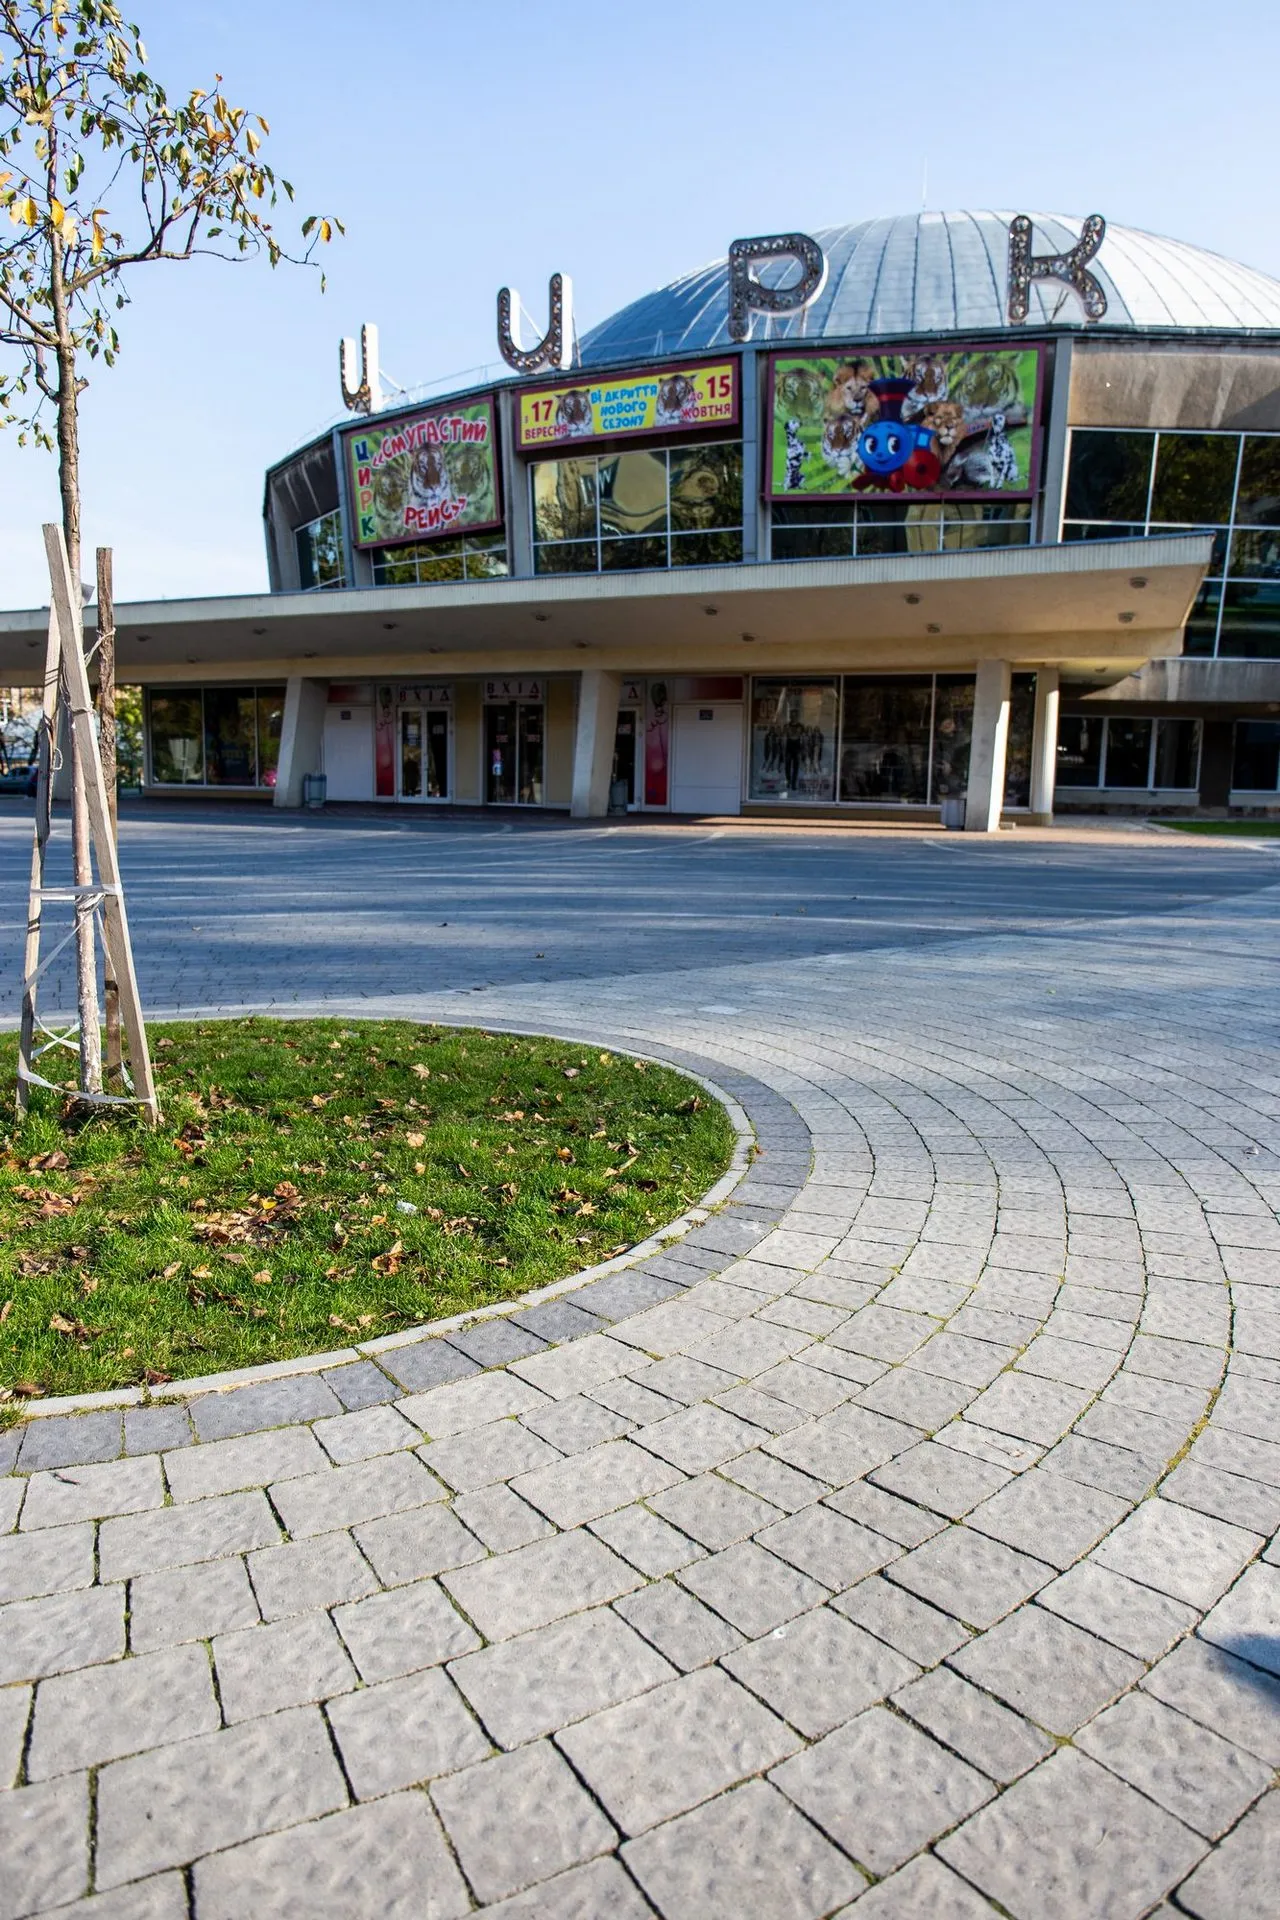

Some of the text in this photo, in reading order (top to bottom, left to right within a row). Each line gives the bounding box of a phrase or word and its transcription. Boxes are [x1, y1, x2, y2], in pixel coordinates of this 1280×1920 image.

[706, 375, 731, 399] 15
[531, 400, 553, 423] 17
[680, 403, 731, 419] ЖОВТНЯ
[602, 415, 645, 430] СЕЗОНУ
[525, 424, 568, 440] ВЕРЕСНЯ
[355, 441, 375, 537] ЦИРК
[487, 681, 539, 694] ВХІД
